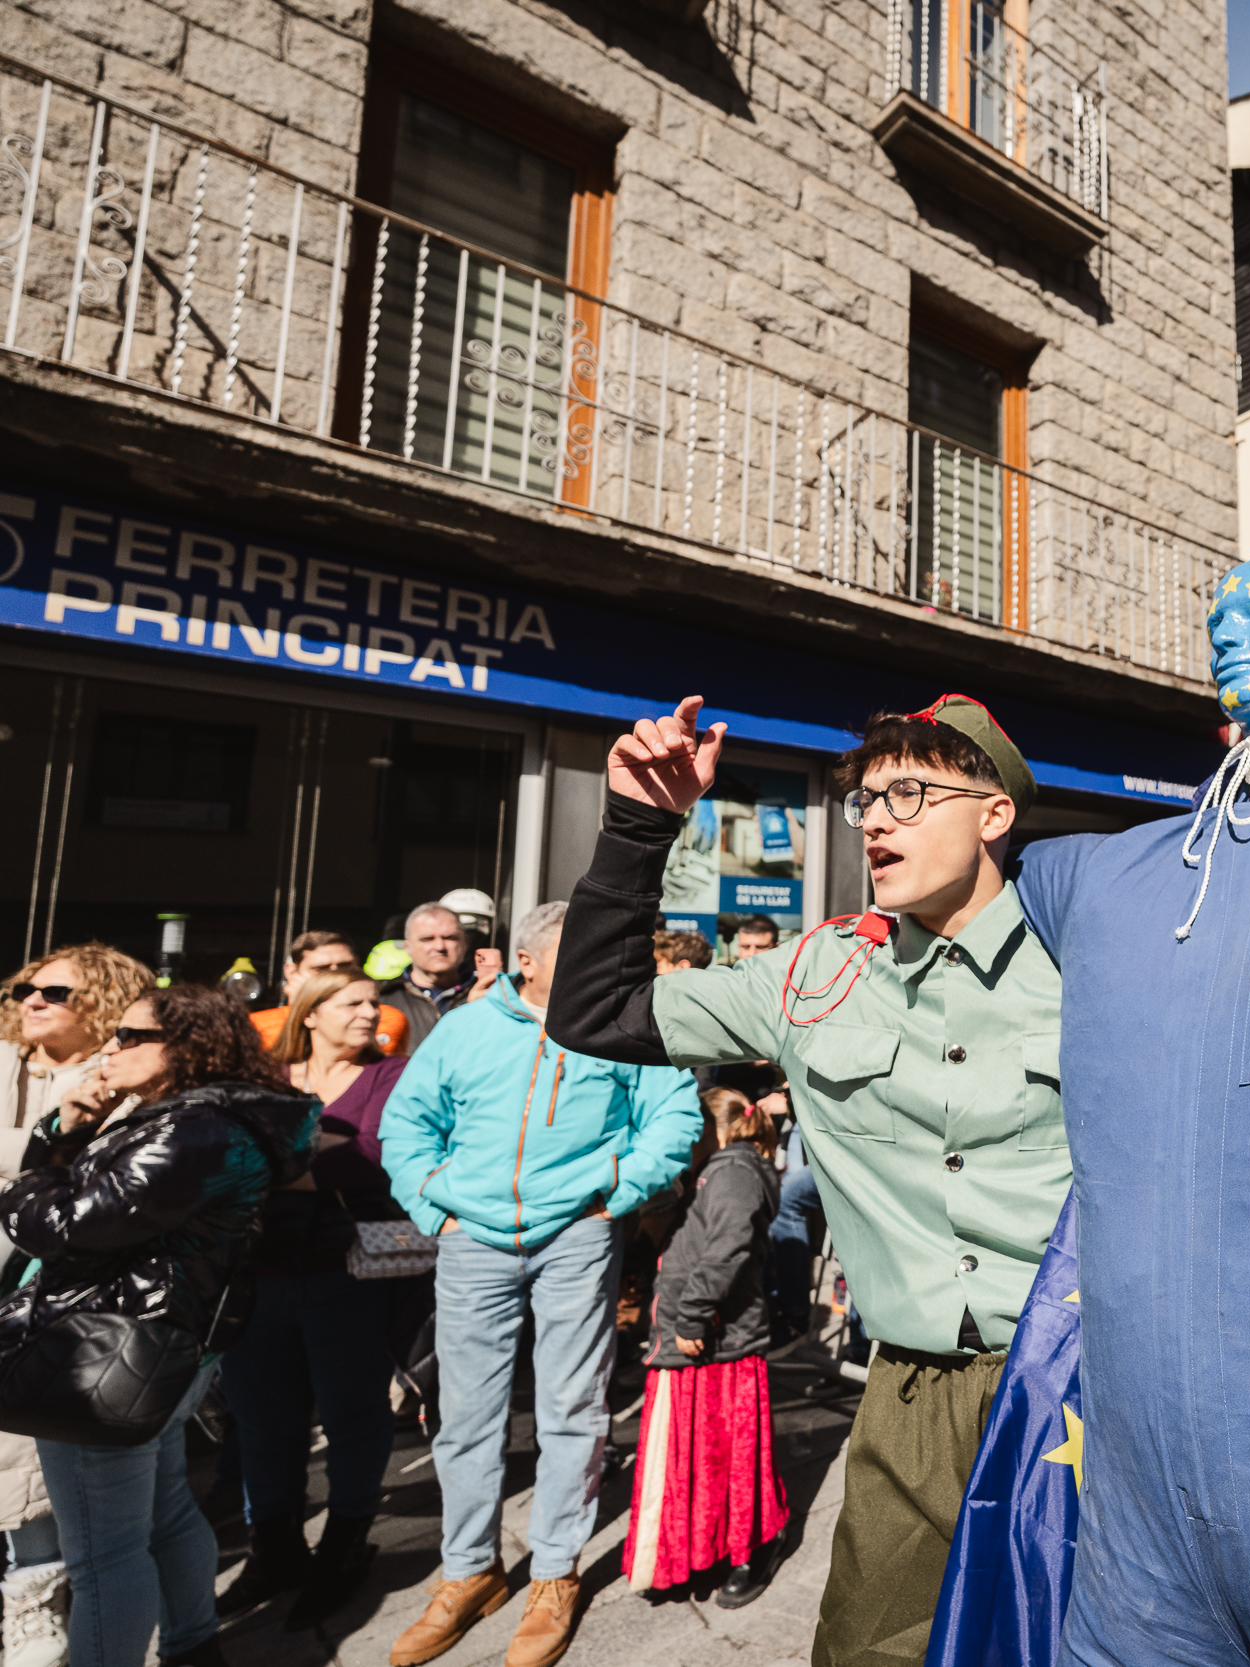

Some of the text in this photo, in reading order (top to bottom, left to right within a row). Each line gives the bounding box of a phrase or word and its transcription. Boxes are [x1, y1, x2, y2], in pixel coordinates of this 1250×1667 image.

[54, 505, 557, 650] FERRETERIA
[43, 568, 503, 692] PRINCIPAT
[736, 885, 790, 896] SEGURETAT
[736, 894, 790, 906] DE LA LLAR
